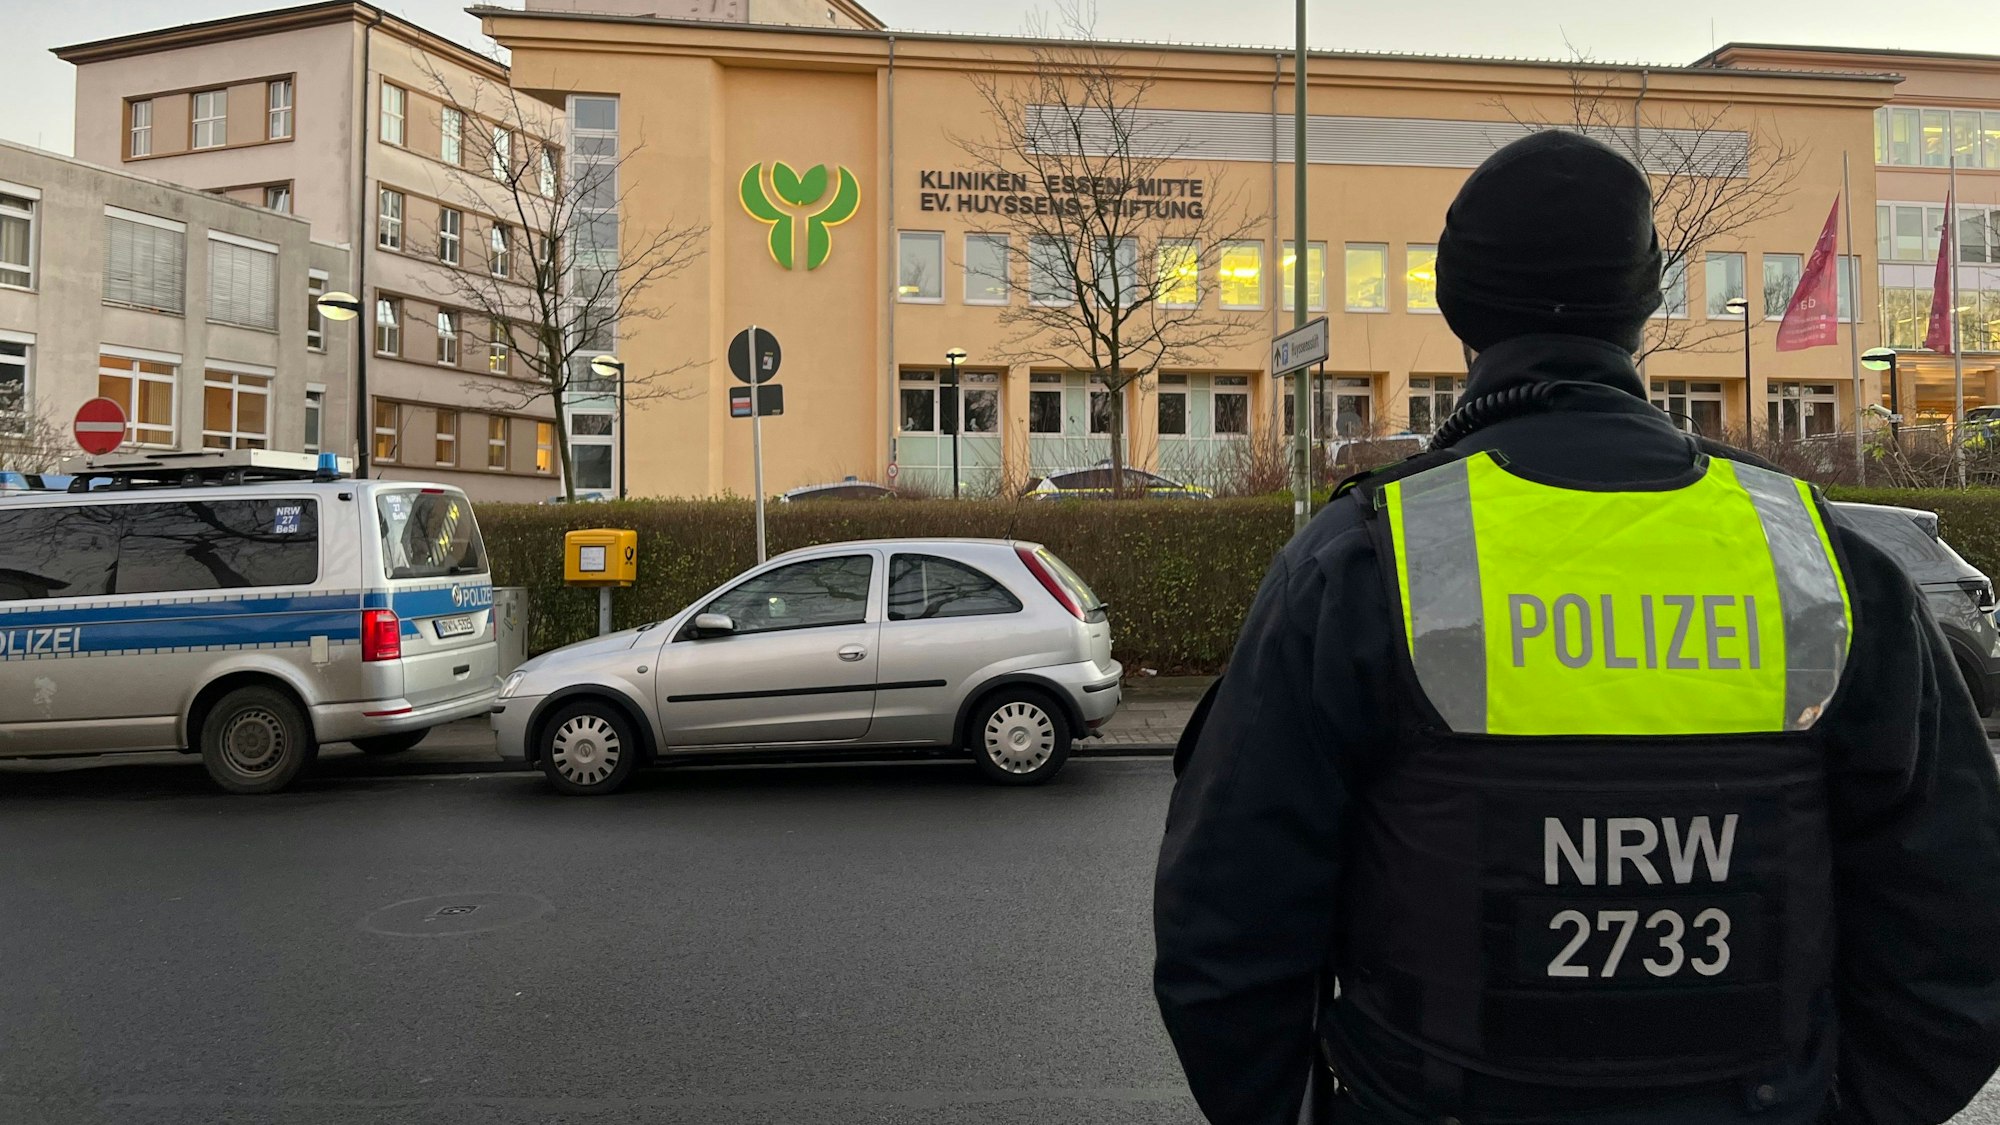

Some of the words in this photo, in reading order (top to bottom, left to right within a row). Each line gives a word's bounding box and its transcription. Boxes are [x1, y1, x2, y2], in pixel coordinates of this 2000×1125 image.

[920, 170, 1026, 192] KLINIKEN
[920, 193, 951, 212] EV.
[276, 506, 301, 516] NRW
[281, 516, 294, 525] 27
[1508, 593, 1761, 670] POLIZEI
[1544, 814, 1739, 886] NRW
[1547, 907, 1731, 978] 2733
